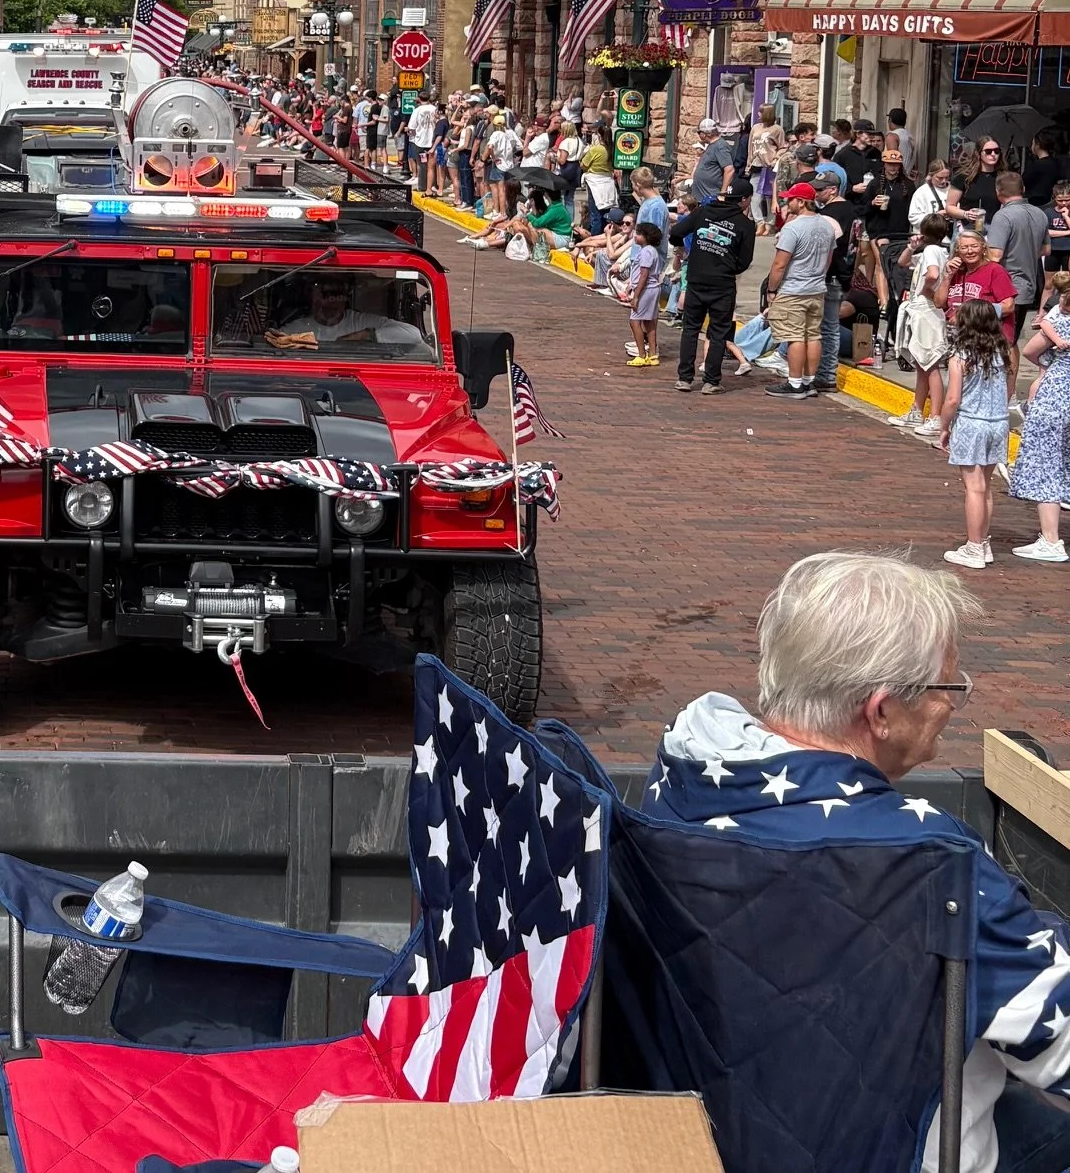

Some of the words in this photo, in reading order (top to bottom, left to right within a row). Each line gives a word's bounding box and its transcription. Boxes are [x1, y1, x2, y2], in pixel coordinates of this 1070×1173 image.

[721, 11, 755, 20] DOOR
[813, 14, 856, 30] HAPPY
[862, 14, 899, 32] DAYS
[904, 15, 954, 35] GIFTS
[395, 43, 430, 58] STOP
[30, 69, 69, 79] LAWRENCE
[71, 69, 100, 79] COUNTY
[27, 79, 56, 89] SEARCH
[57, 80, 73, 89] AND
[75, 80, 103, 89] RESCUE
[621, 113, 642, 121] STOP
